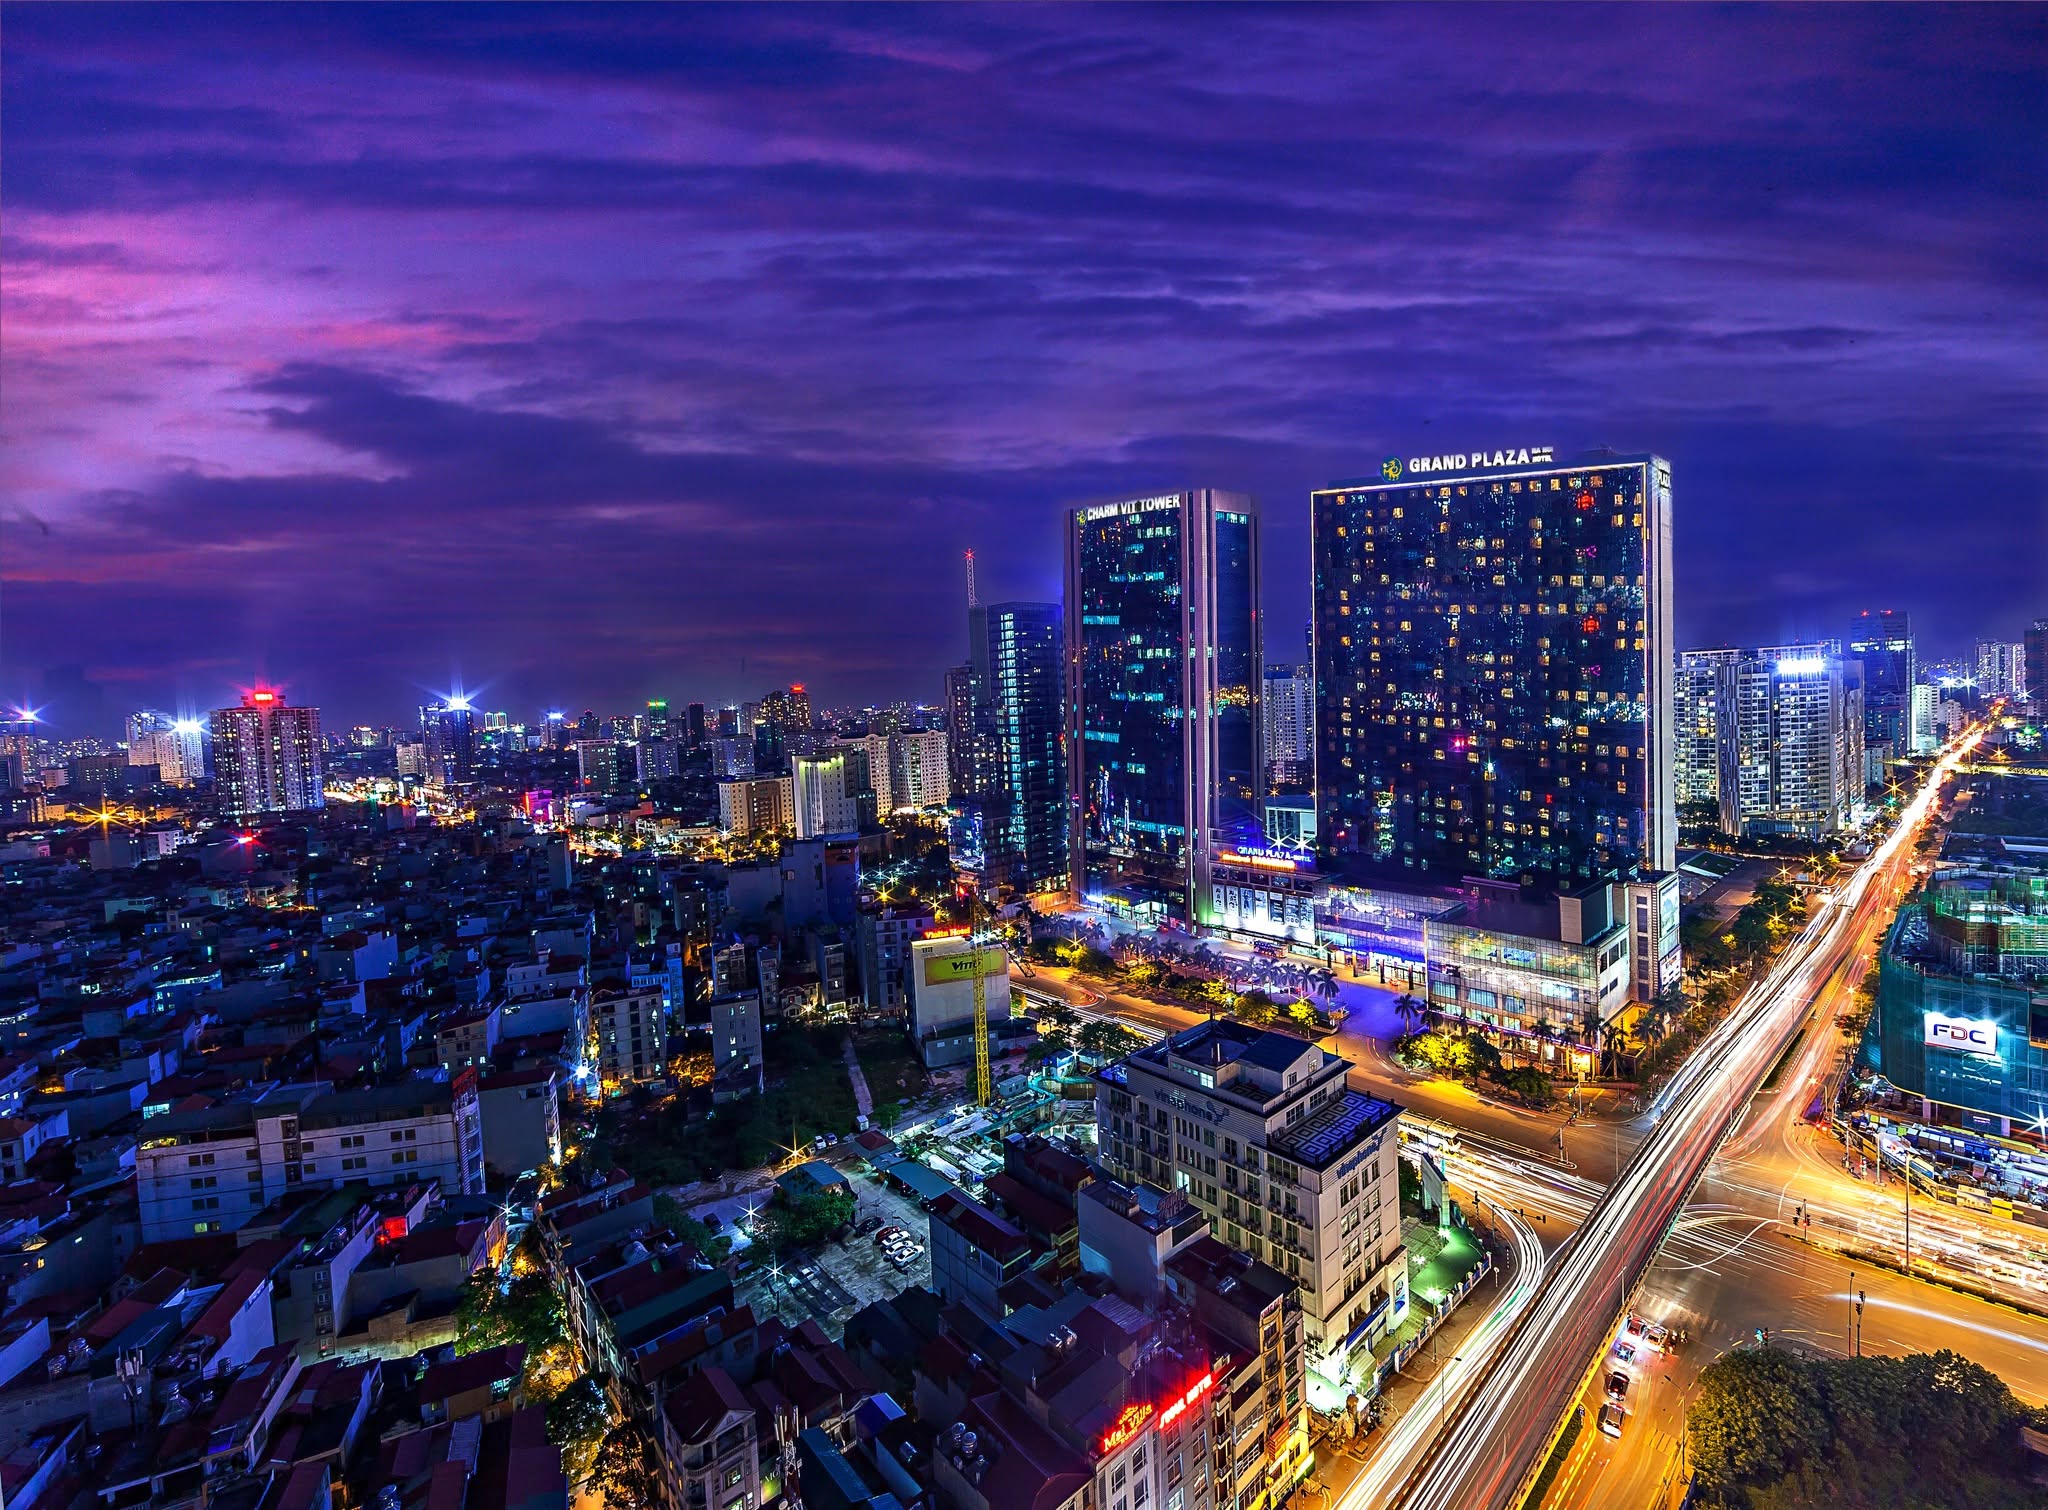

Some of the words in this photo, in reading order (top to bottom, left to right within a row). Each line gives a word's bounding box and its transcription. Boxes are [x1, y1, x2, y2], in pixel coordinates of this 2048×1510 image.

[1409, 454, 1467, 472] GRAND
[1471, 448, 1530, 468] PLAZA
[1087, 503, 1118, 521] CHARM
[1120, 499, 1138, 515] VIT
[1139, 494, 1181, 512] TOWER
[1933, 1023, 1987, 1045] FDC
[1127, 1404, 1153, 1429] Villa
